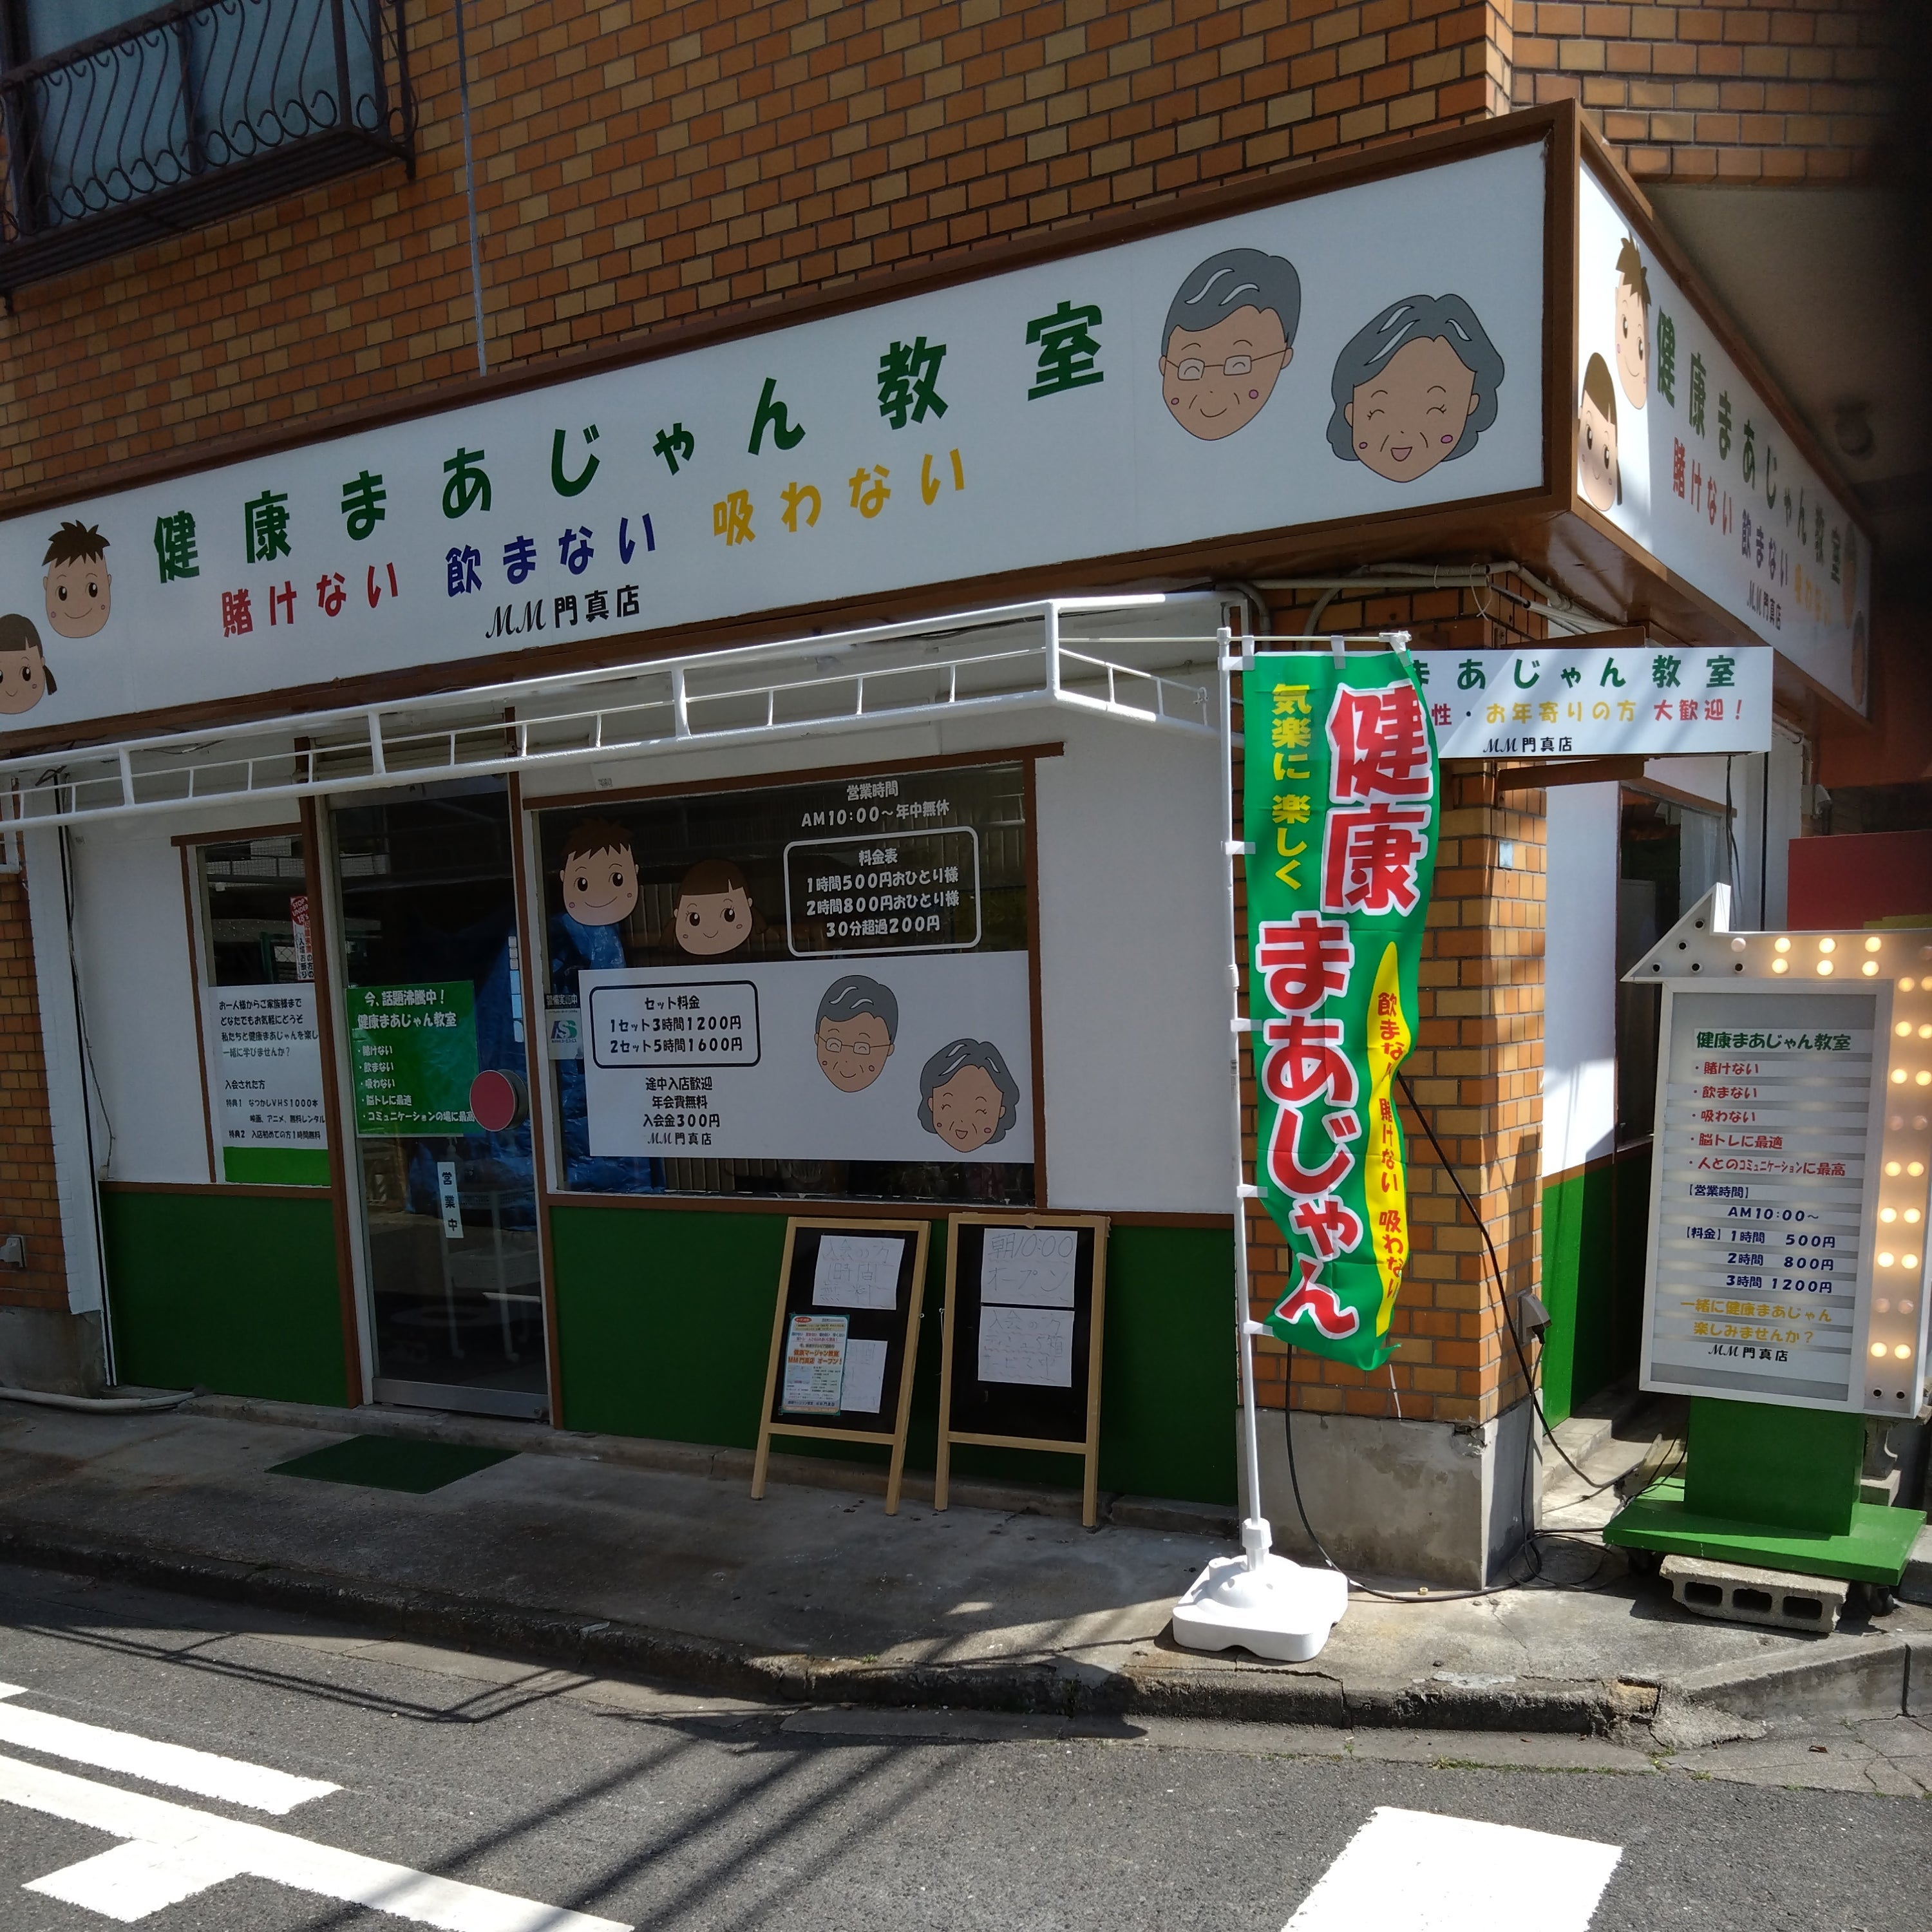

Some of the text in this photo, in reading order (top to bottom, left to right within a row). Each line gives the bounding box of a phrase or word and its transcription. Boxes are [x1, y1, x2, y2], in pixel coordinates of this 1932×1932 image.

[153, 301, 1104, 583] 健康まあじゃん教室
[1672, 437, 1732, 536] 賭けない
[221, 448, 965, 638] 賭けない 飲まない 吸わない
[846, 780, 900, 802] 営業時間
[1271, 683, 1312, 891] 気楽に 楽しく
[858, 848, 898, 867] 料金表
[292, 898, 305, 909] STOP
[292, 904, 309, 916] UNDER
[826, 914, 940, 938] 30分超過200円
[645, 995, 701, 1010] セット料金
[357, 1011, 457, 1029] 健康まあじゃん教室
[610, 1014, 742, 1033] 1セット3時間1200円
[610, 1036, 743, 1054] 2セット5時間1600円
[1696, 1032, 1852, 1051] 健康まあじゃん教室
[225, 1079, 266, 1091] 入会された方
[645, 1076, 713, 1092] 途中入店歓迎
[652, 1095, 708, 1110] 年会費無料
[643, 1113, 721, 1128] 入会金300円
[442, 1171, 458, 1231] 営業中
[1730, 1230, 1765, 1244] 1時間
[1785, 1234, 1836, 1249] 500円
[1727, 1252, 1834, 1271] 2時間 800円
[1725, 1274, 1833, 1294] 3時間 1200円
[1680, 1298, 1832, 1322] 一緒に健康まあじゃん
